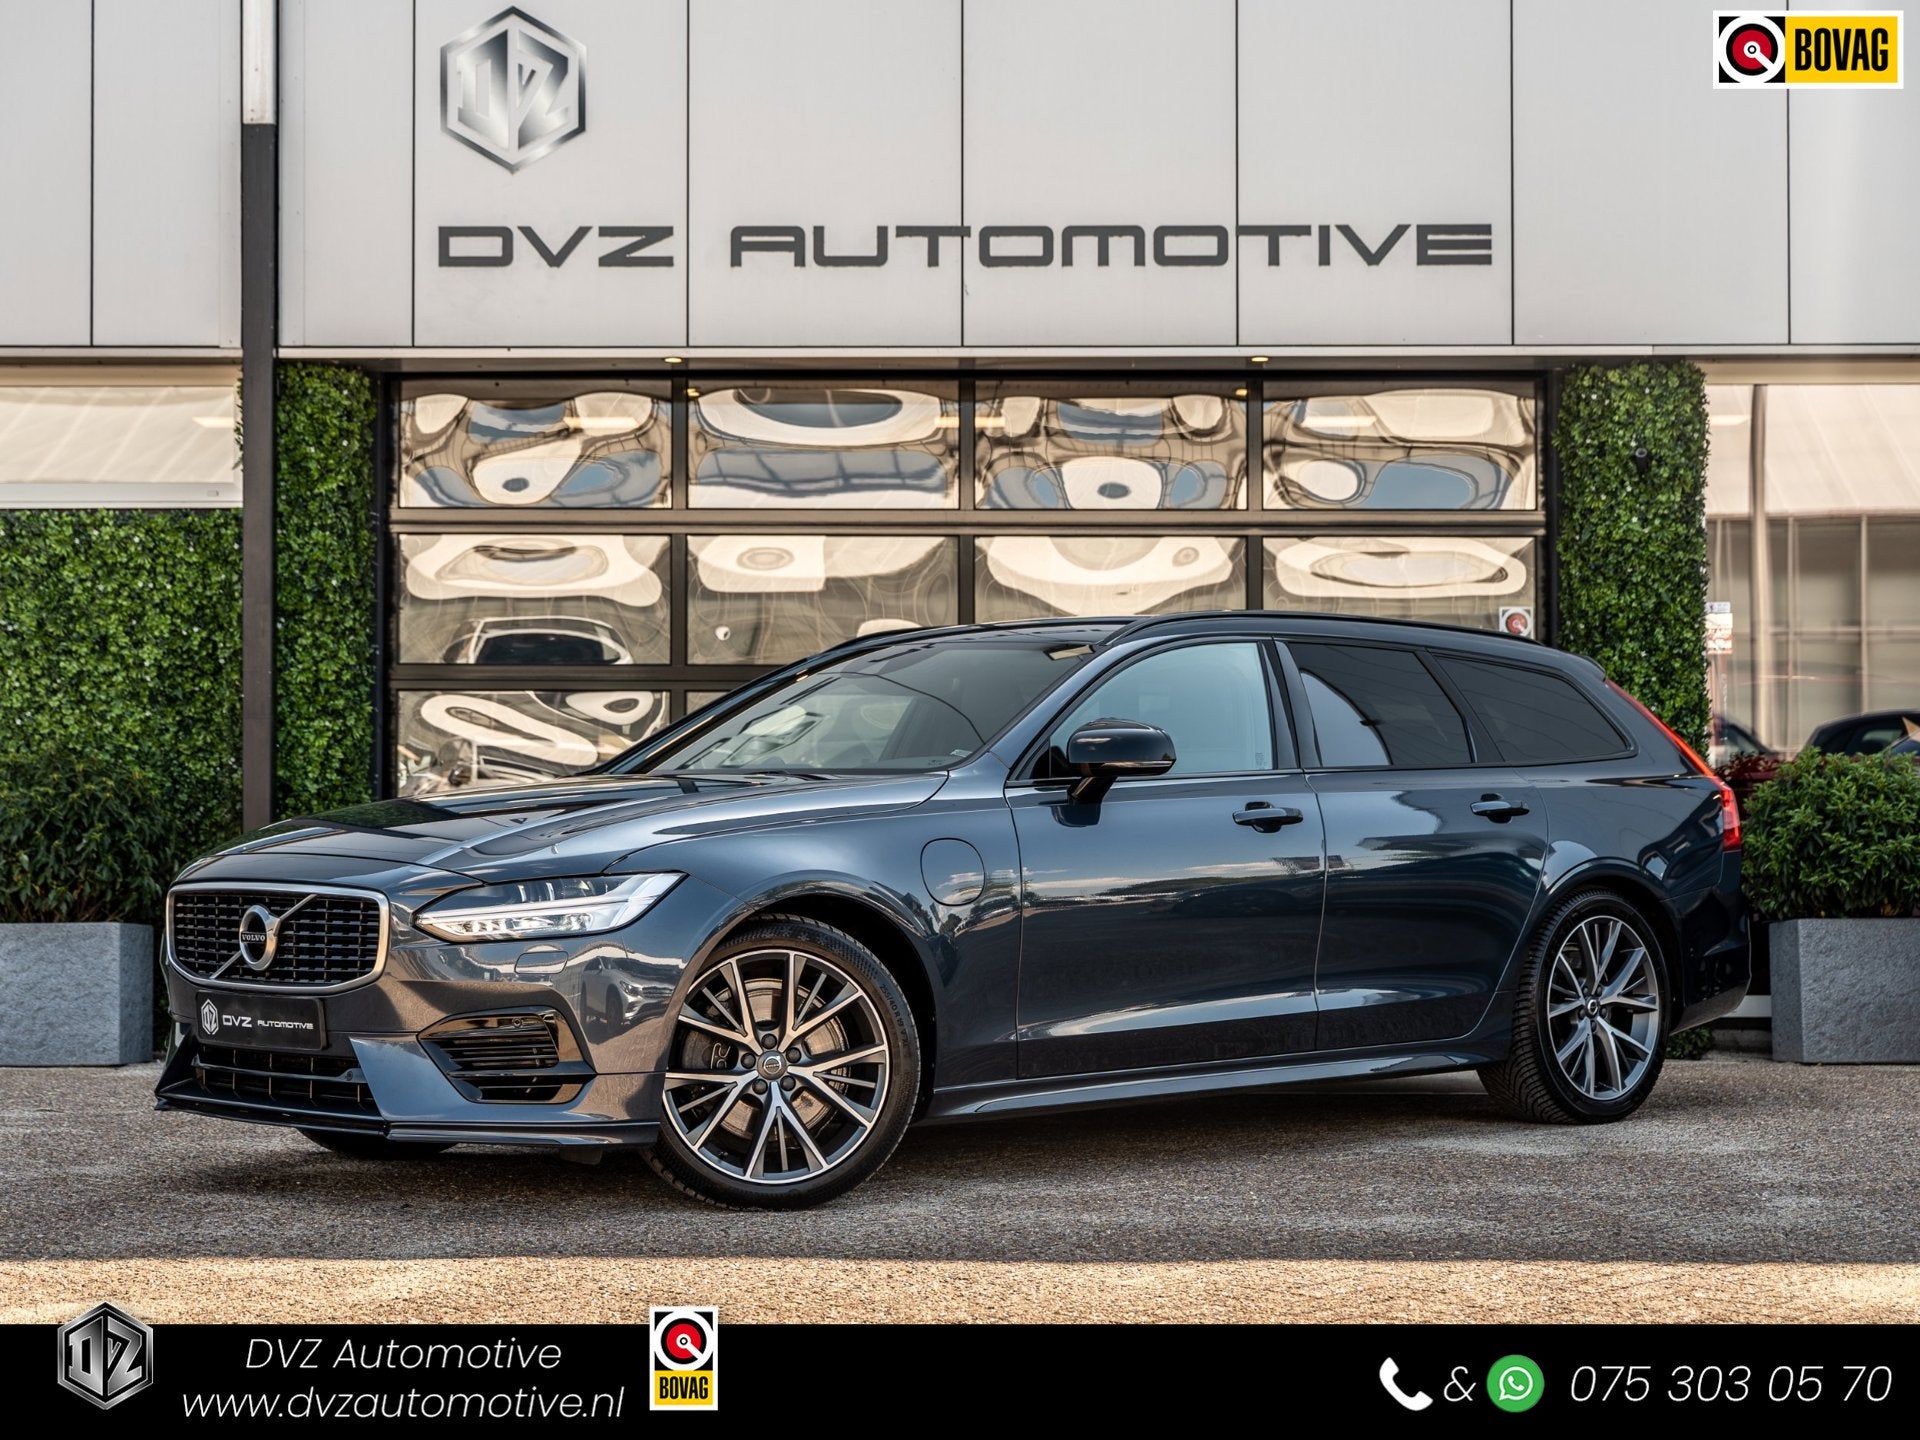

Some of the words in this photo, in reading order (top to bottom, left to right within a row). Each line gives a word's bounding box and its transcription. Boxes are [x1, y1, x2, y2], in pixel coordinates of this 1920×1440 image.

[438, 225, 675, 268] DVZ
[730, 223, 1493, 268] AUTOMOTIVE
[241, 934, 266, 942] VOLVO
[222, 1014, 253, 1028] DVZ
[257, 1019, 314, 1030] AUTOMOTIVE
